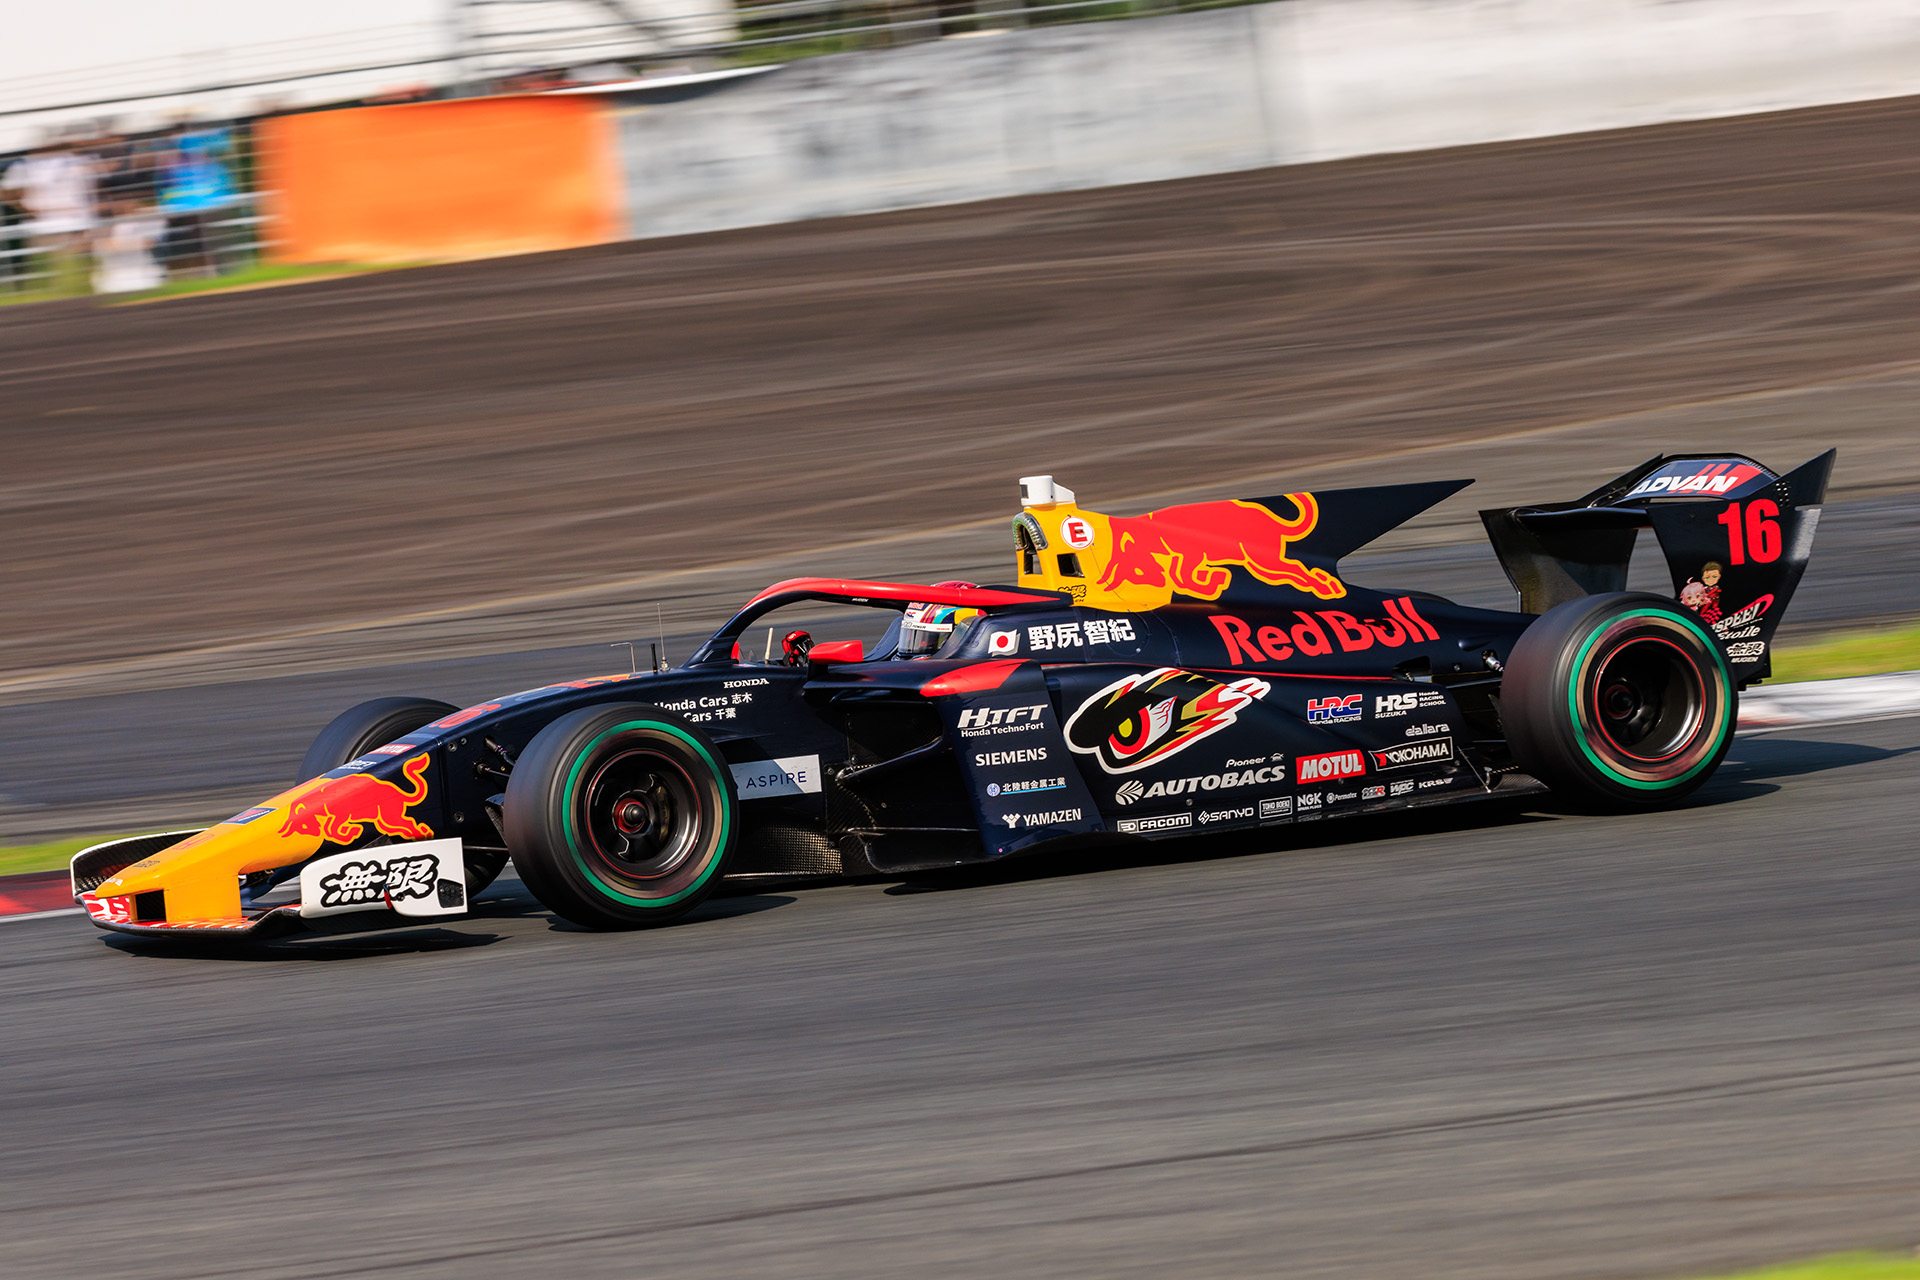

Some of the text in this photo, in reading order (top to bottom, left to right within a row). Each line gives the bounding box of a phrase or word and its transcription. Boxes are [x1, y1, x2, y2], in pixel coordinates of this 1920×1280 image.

[1626, 475, 1739, 497] ADVAN
[1067, 521, 1089, 544] E
[1717, 498, 1783, 566] 16
[1207, 596, 1441, 666] Red Bull
[723, 677, 770, 689] HONDA
[699, 695, 729, 708] Cars
[731, 692, 753, 705] 志木
[1307, 693, 1363, 721] HRC
[1375, 692, 1418, 713] HRS
[1419, 694, 1444, 702] RACING
[1419, 700, 1447, 708] SCHOOL
[715, 707, 737, 720] 千葉
[957, 703, 1049, 729] HTFT
[1374, 710, 1408, 719] SUZUKA
[961, 728, 991, 738] Honda
[1404, 723, 1451, 737] dallara
[975, 747, 1048, 767] SIEMENS
[1225, 756, 1266, 768] Pioneer
[1385, 743, 1450, 764] YOKOHAMA
[1300, 752, 1363, 780] MOTUL
[746, 771, 808, 789] ASPIRE
[1143, 765, 1287, 799] AUTOBACS
[1297, 792, 1322, 807] NGK
[1023, 808, 1082, 827] YAMAZEN
[1139, 815, 1191, 831] FACOM
[1208, 807, 1255, 822] SANYO
